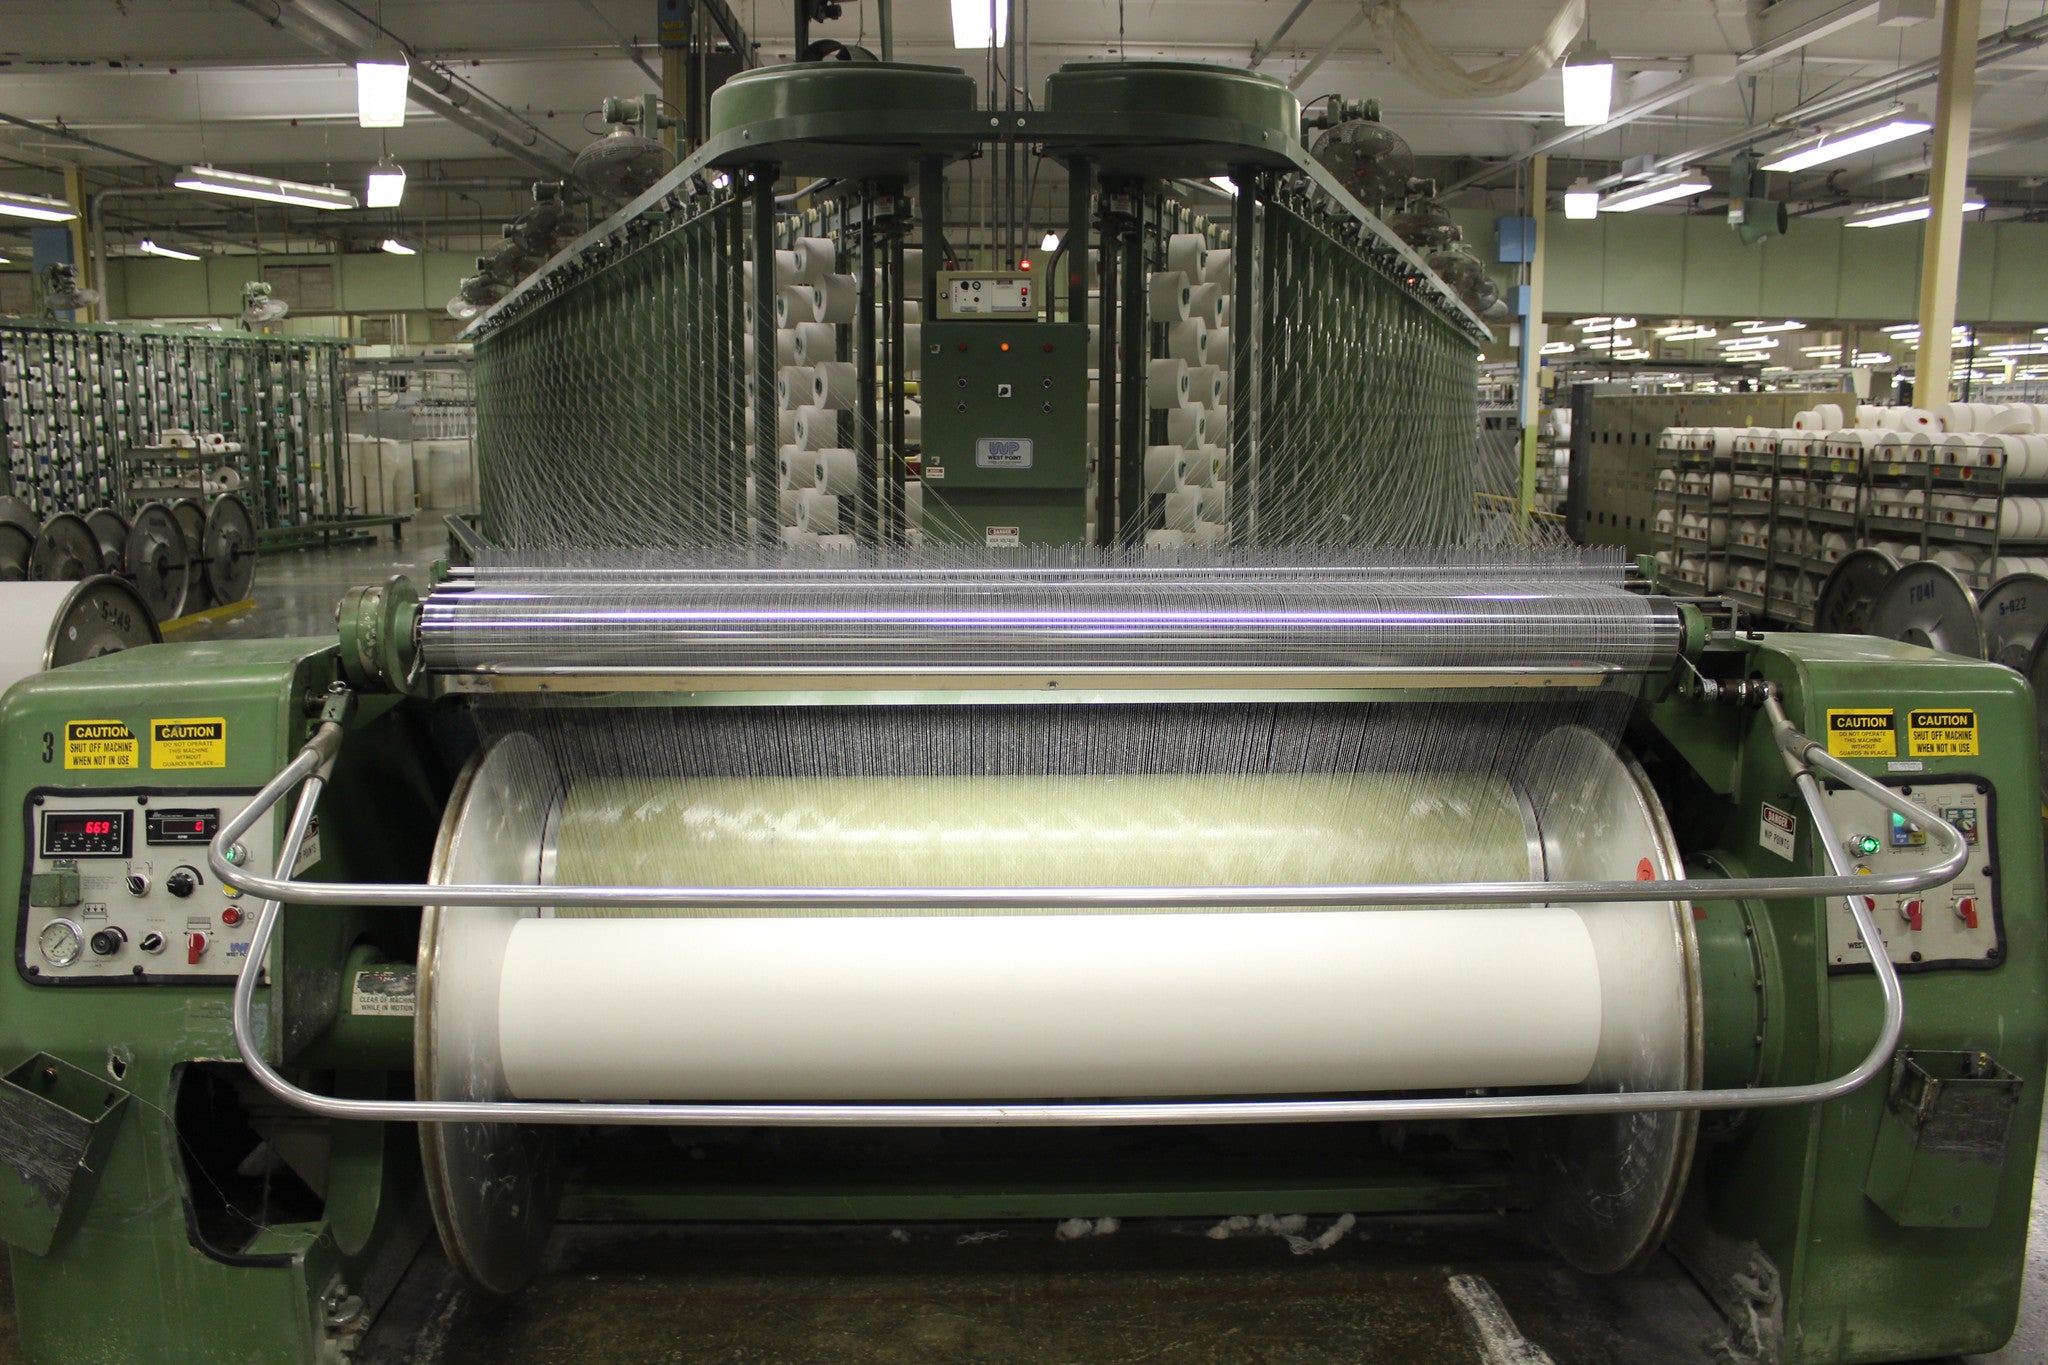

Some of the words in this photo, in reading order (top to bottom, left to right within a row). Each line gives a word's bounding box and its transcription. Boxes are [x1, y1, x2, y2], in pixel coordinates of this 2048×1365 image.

[1837, 717, 1887, 728] CAUTION
[1918, 715, 1968, 726] CAUTION
[76, 726, 129, 738] CAUTION
[161, 726, 215, 738] CAUTION
[1913, 731, 1929, 740] SHUT
[1931, 731, 1942, 740] OFF
[1945, 731, 1972, 740] MACHINE
[42, 731, 54, 764] 3
[70, 743, 87, 753] SHUT
[89, 743, 101, 752] OFF
[104, 742, 133, 752] MACHINE
[1916, 743, 1934, 753] WHEN
[1936, 743, 1948, 752] NOT
[1950, 743, 1957, 752] IN
[1958, 743, 1971, 752] USE
[73, 756, 92, 766] WHEN
[94, 755, 106, 766] NOT
[109, 755, 115, 765] IN
[117, 755, 130, 765] USE
[1768, 810, 1788, 828] DANGER
[85, 821, 110, 834] 669
[1773, 833, 1790, 850] POINTS
